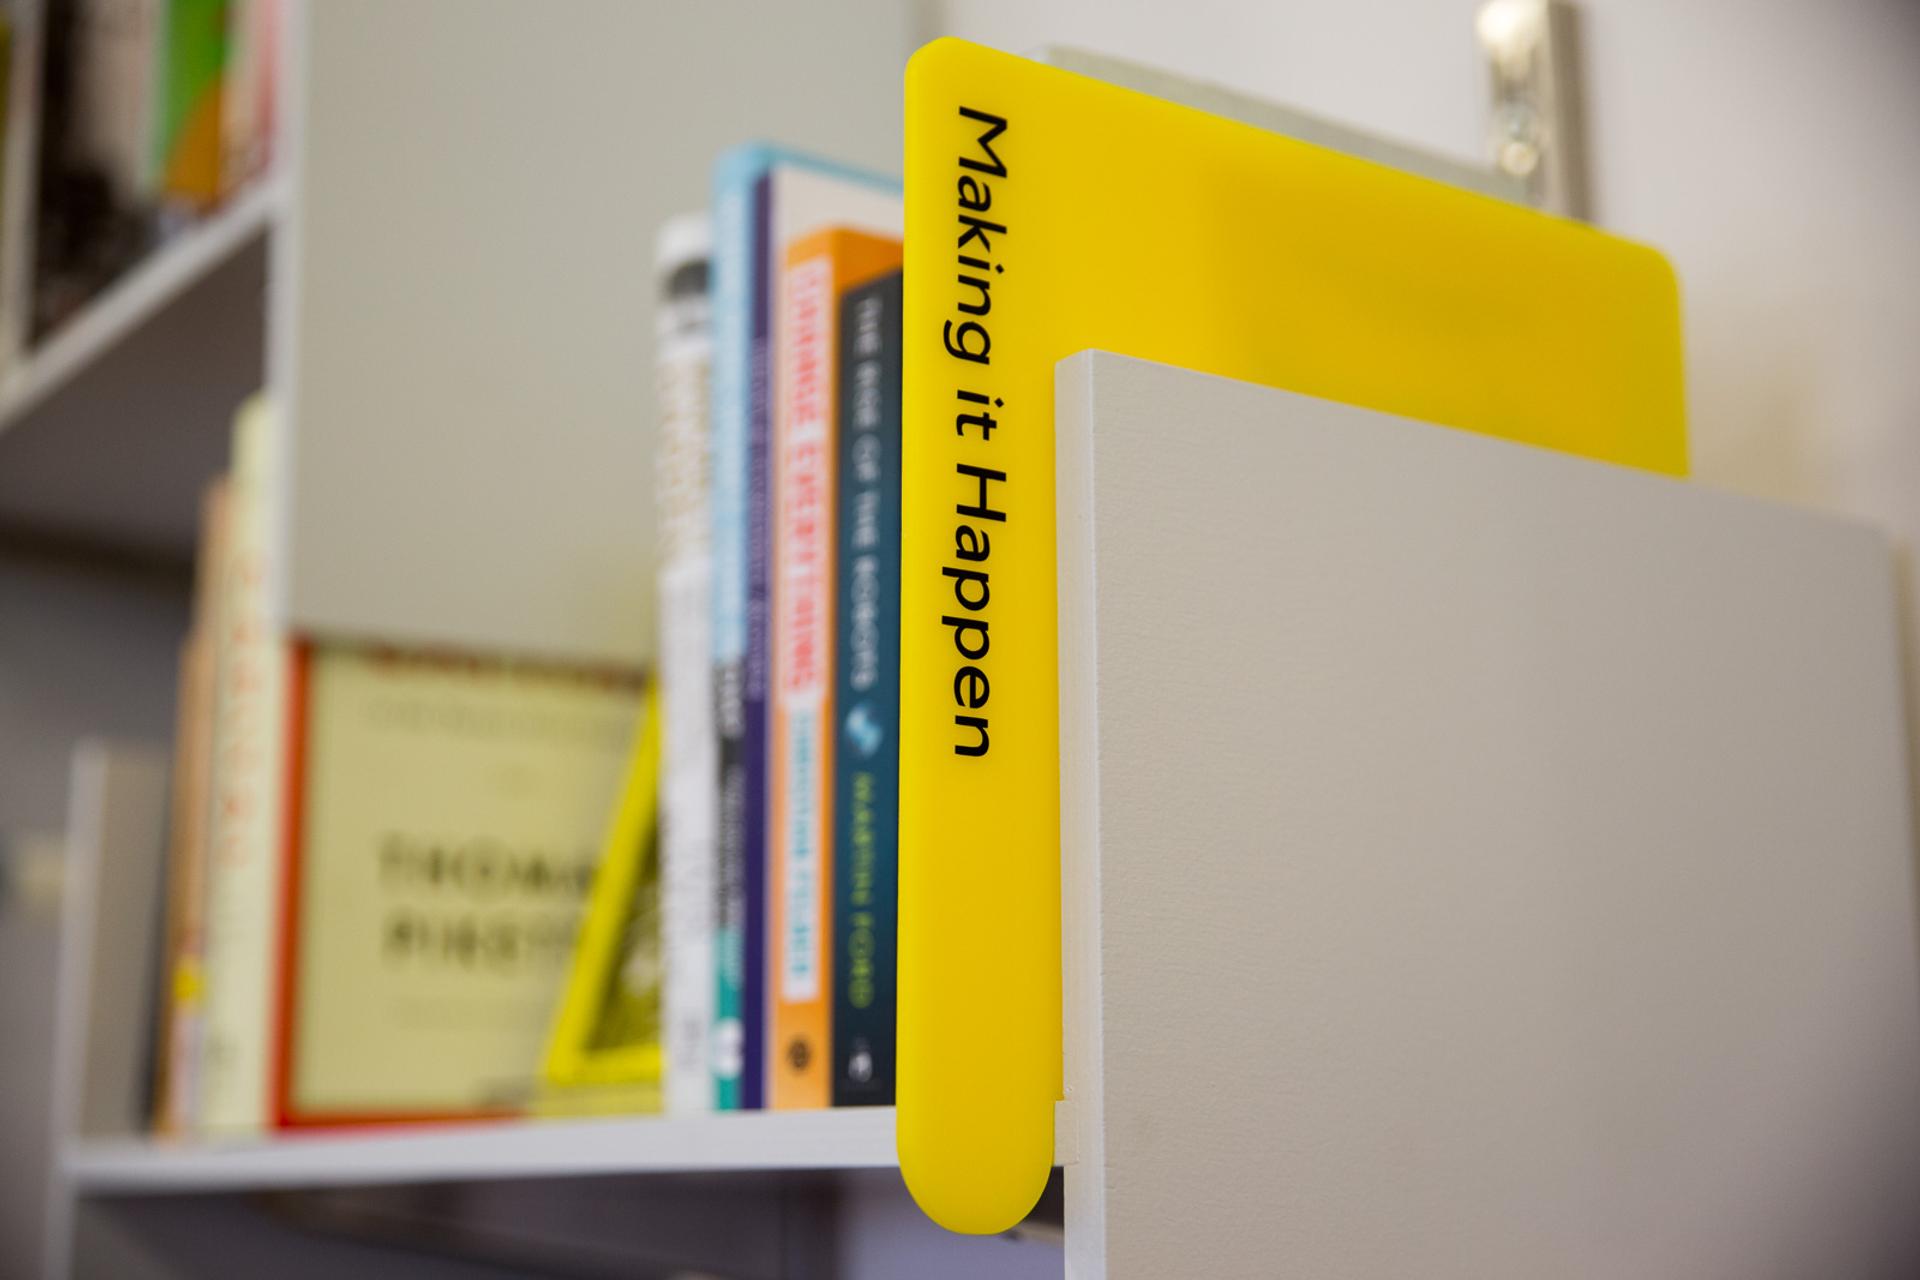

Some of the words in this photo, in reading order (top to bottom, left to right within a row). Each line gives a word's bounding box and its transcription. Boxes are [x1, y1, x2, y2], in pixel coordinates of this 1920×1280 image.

[943, 106, 1008, 365] Making
[853, 297, 883, 355] THE
[956, 389, 1005, 440] it
[852, 433, 882, 482] OF
[852, 490, 881, 549] THE
[850, 554, 880, 690] ROBOTS
[941, 463, 1007, 757] Happen
[848, 910, 875, 1008] FORD
